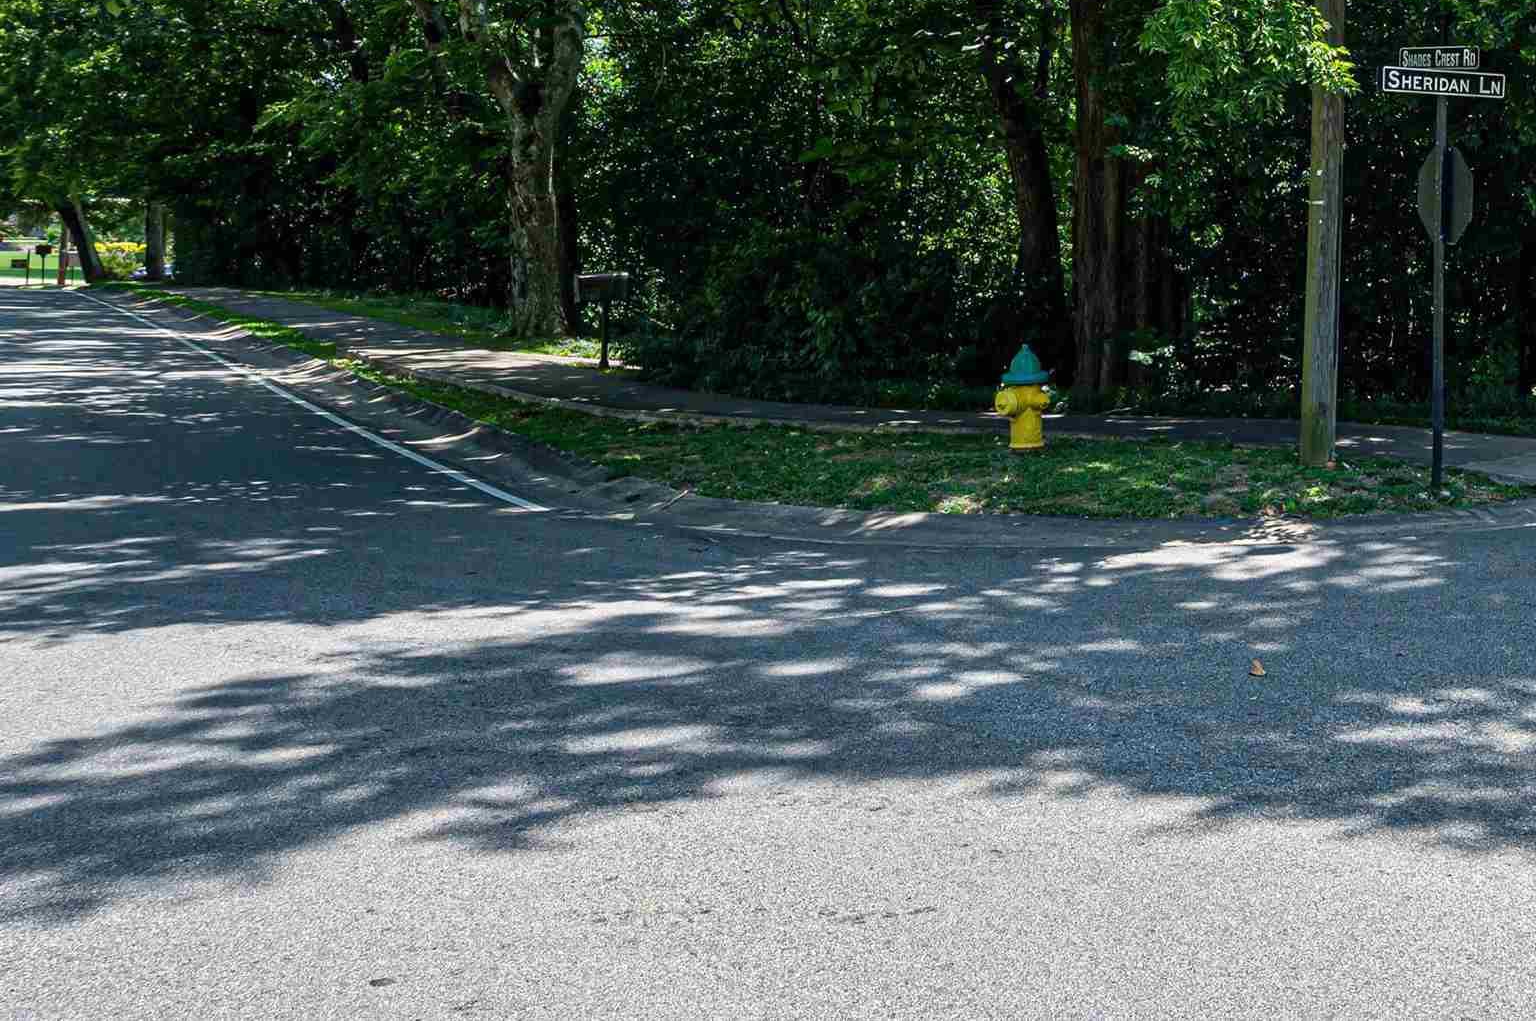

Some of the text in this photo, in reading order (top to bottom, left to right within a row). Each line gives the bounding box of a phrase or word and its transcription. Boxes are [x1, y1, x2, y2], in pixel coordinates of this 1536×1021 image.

[1402, 48, 1476, 67] SHADES CREST RD
[1388, 70, 1501, 95] SHERIDAN LN
